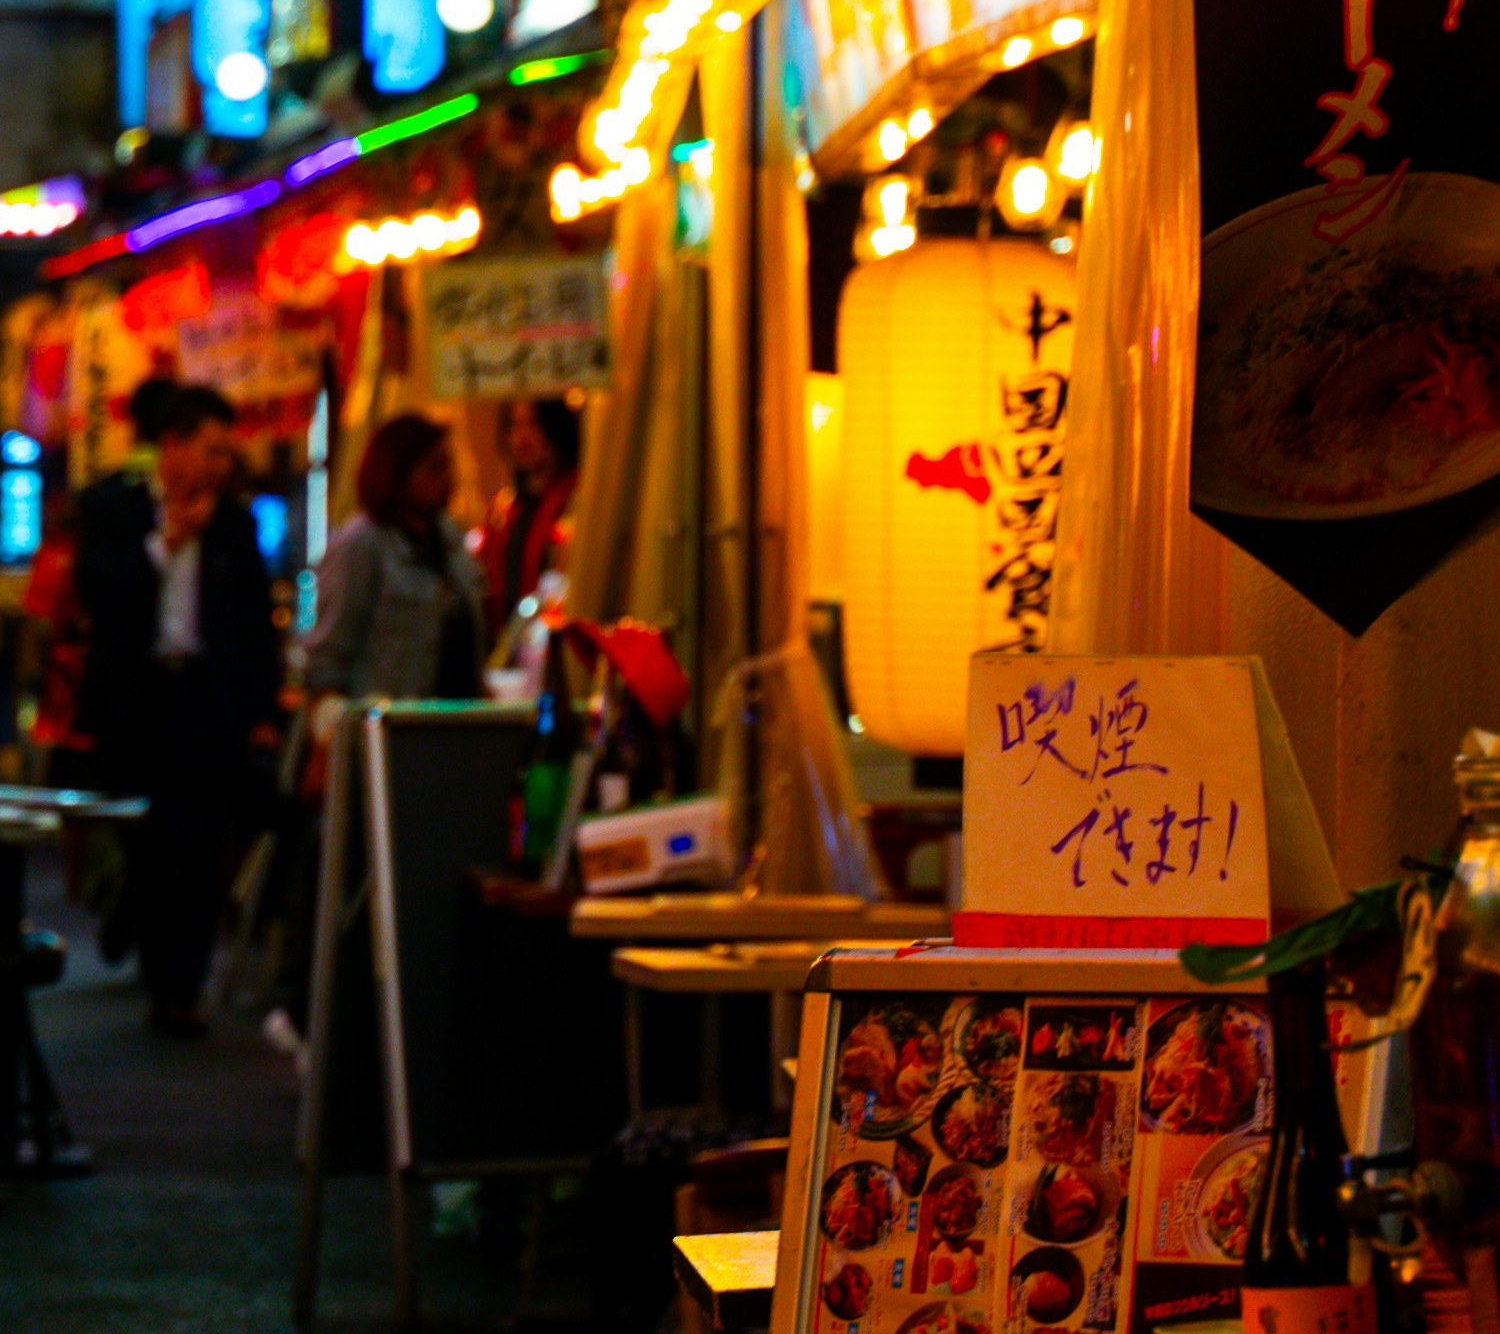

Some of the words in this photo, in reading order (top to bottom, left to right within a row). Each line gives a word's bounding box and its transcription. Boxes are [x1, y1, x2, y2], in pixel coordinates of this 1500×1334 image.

[996, 675, 1169, 786] 喫煙
[1050, 781, 1239, 889] できます!
